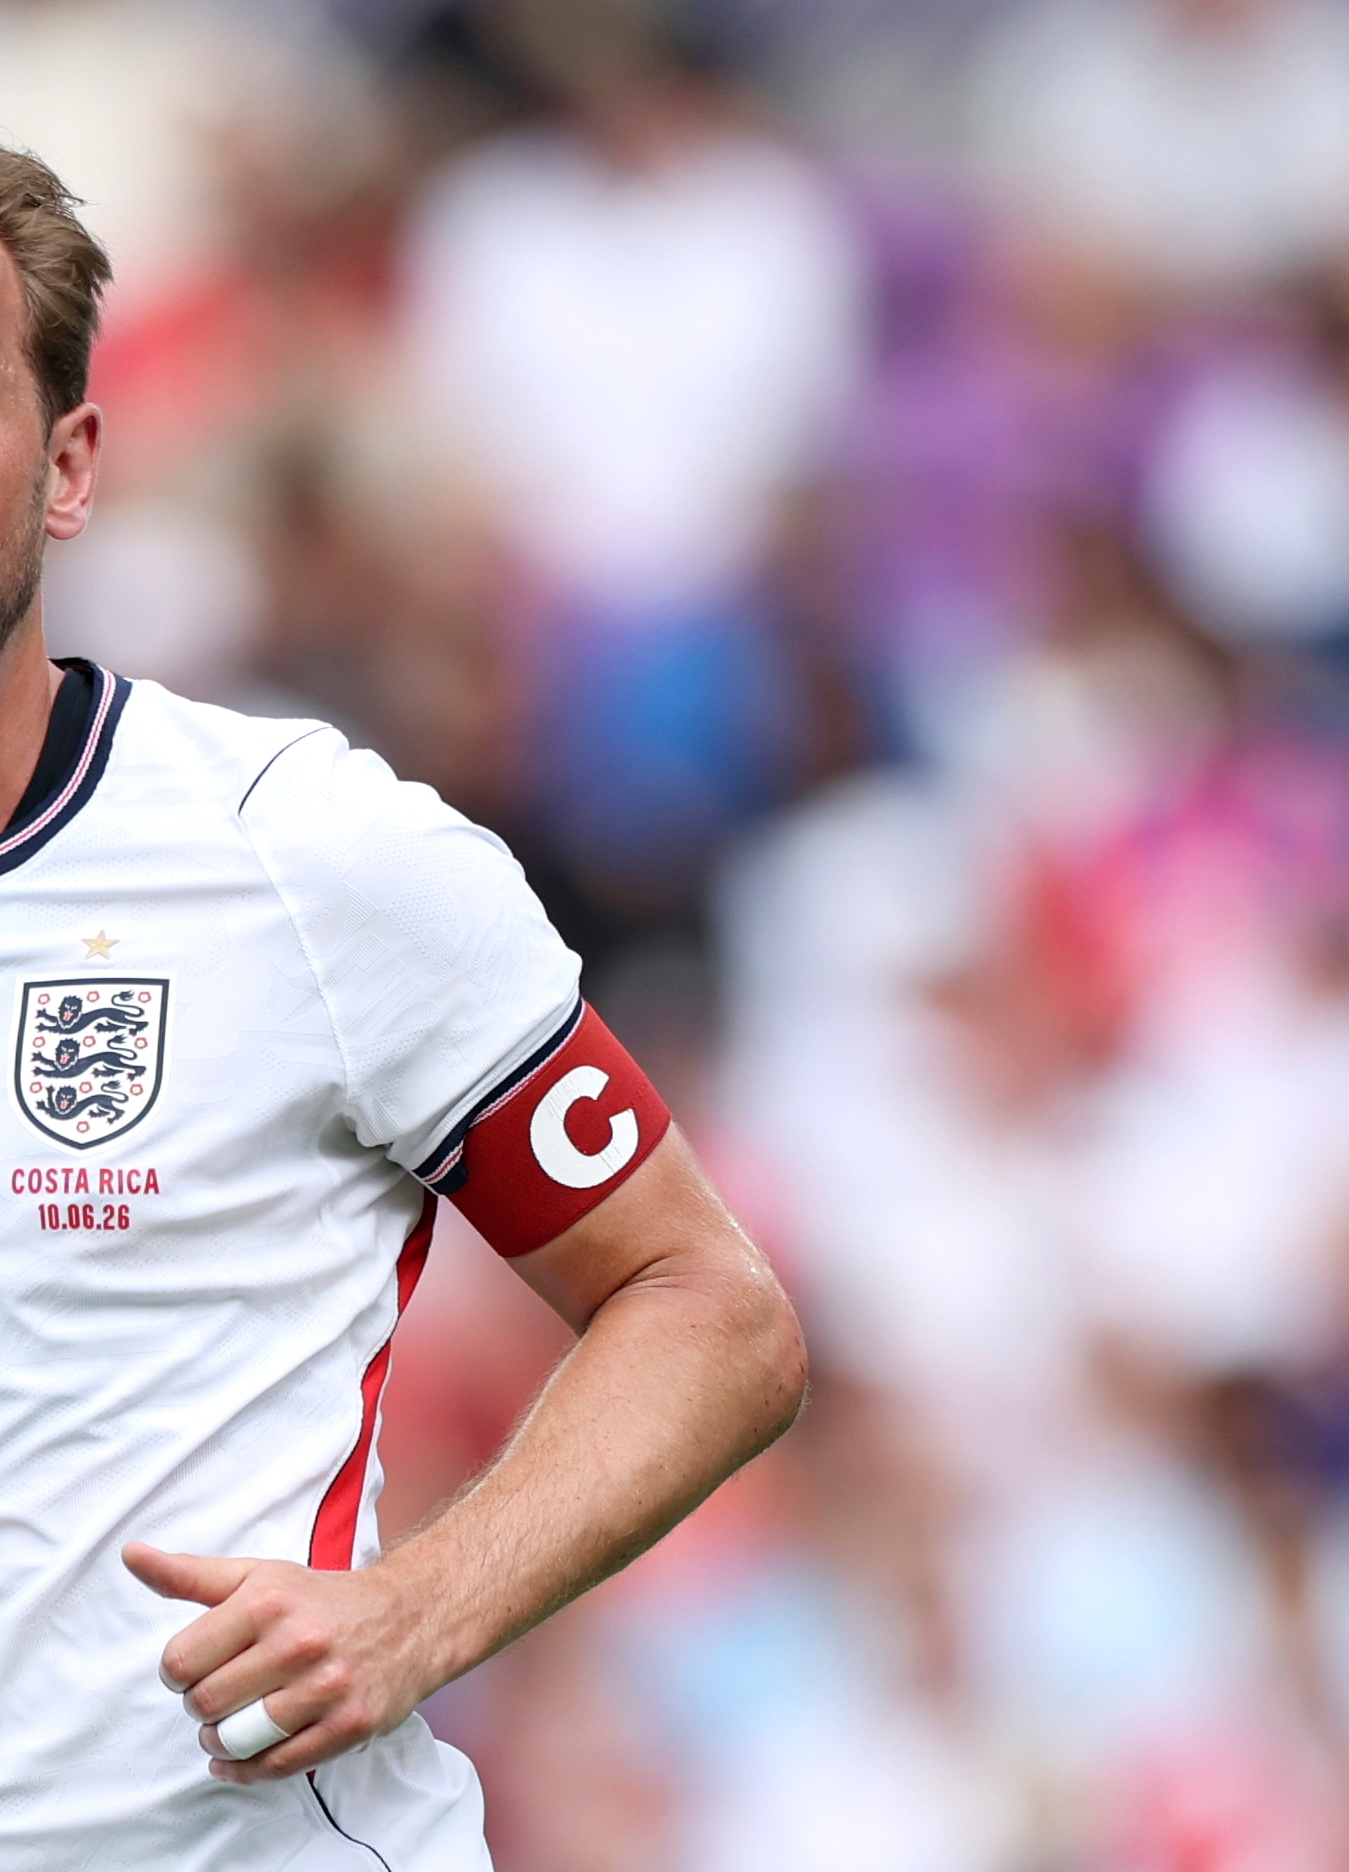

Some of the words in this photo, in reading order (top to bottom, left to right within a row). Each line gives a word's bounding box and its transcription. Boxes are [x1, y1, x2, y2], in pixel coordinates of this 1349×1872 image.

[530, 1065, 639, 1189] C
[12, 1168, 90, 1194] COSTA
[99, 1168, 160, 1194] RICA
[38, 1203, 130, 1230] 10.06.26
